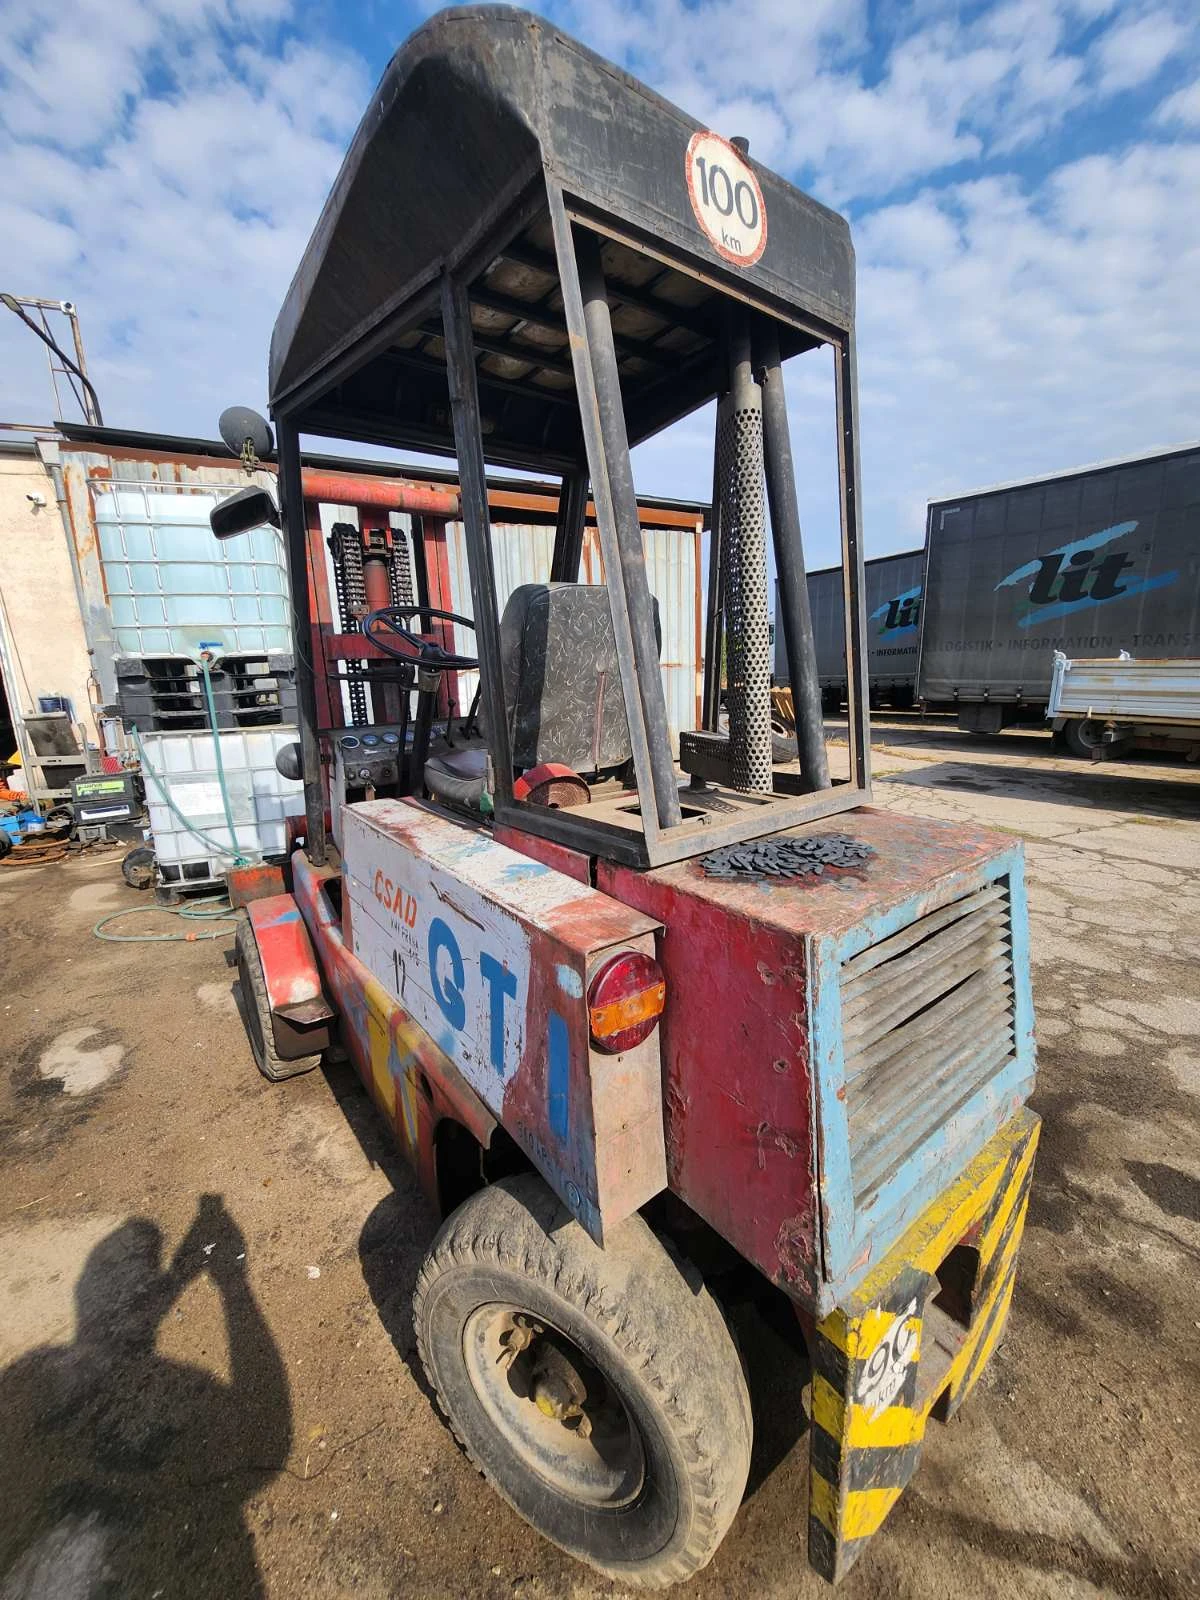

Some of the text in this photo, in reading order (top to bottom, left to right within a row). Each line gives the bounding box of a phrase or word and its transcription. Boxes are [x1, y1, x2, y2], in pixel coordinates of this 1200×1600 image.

[695, 156, 759, 230] 100
[721, 227, 742, 254] km
[1029, 550, 1135, 604] lit
[1008, 635, 1113, 651] INFORMATION
